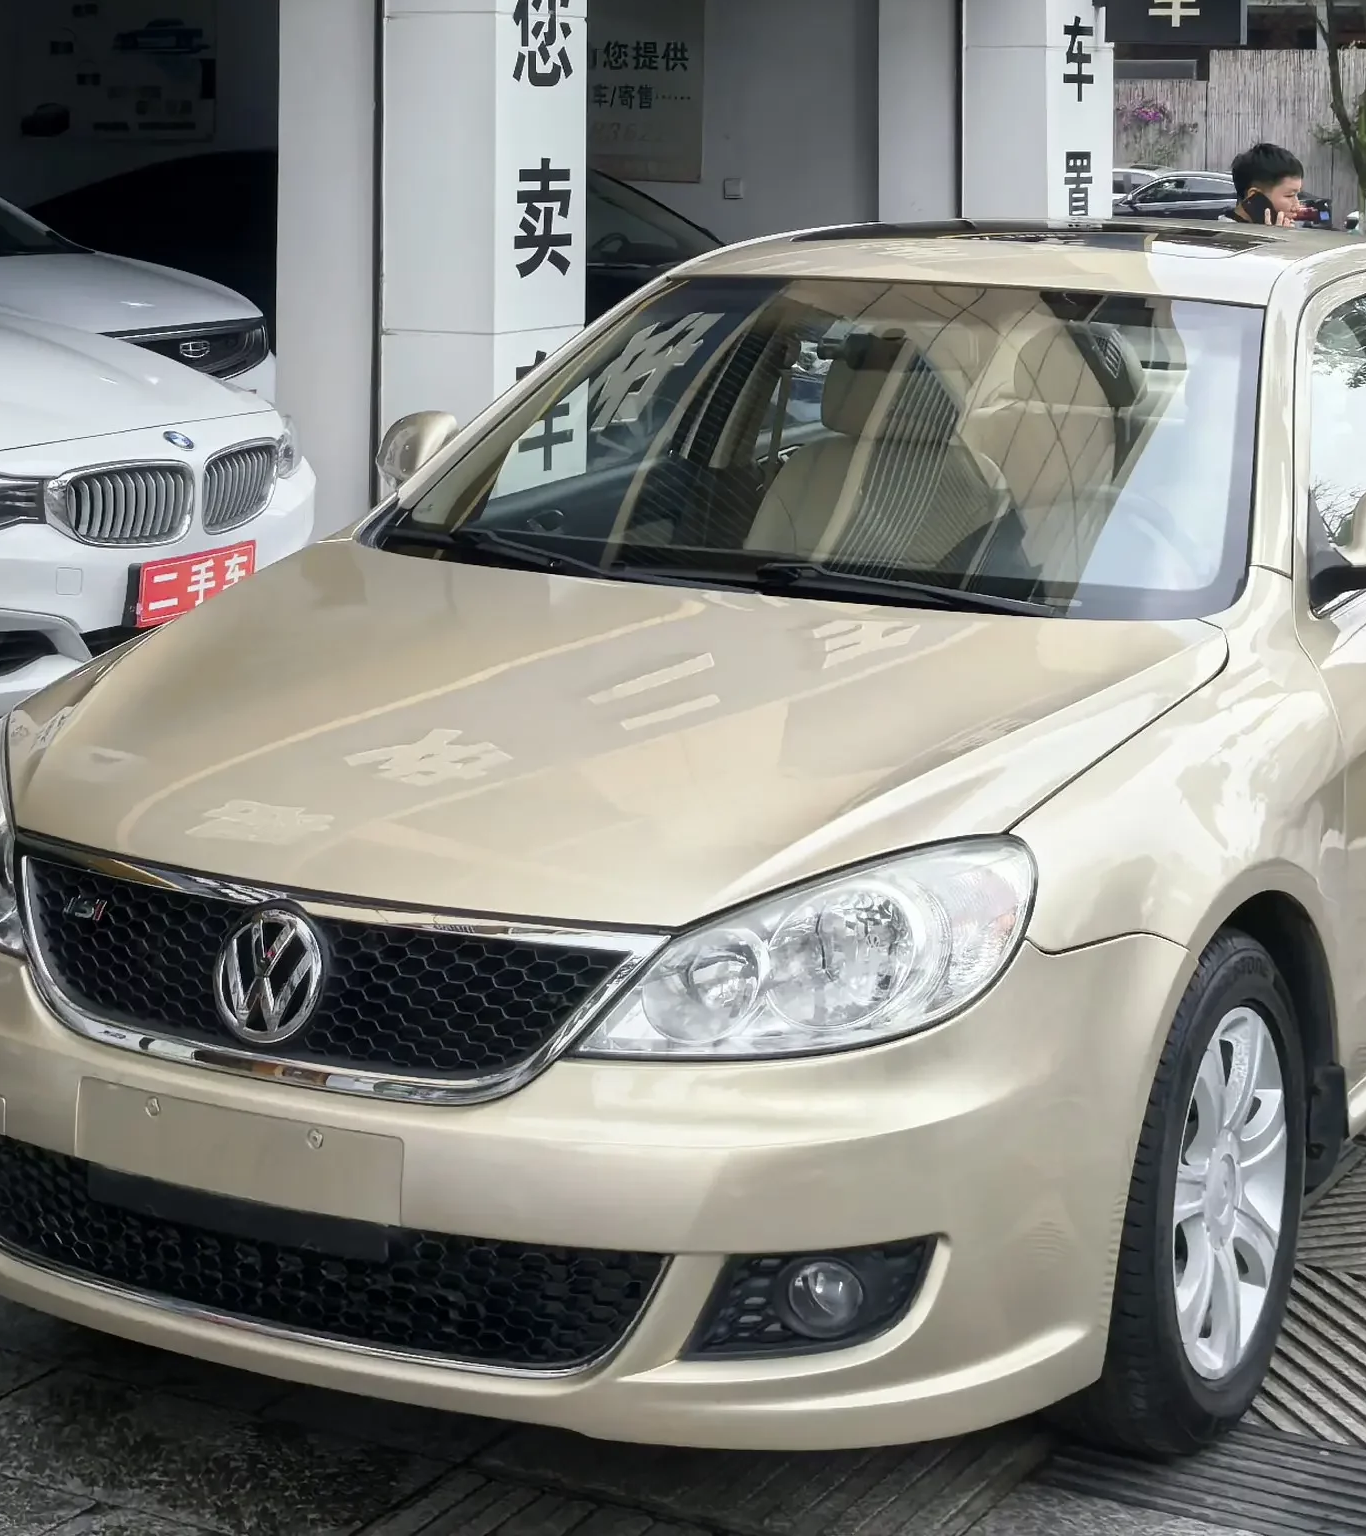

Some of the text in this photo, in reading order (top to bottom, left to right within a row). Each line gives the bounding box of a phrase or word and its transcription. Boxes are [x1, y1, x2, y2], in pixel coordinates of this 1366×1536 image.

[589, 40, 689, 71] 您提供
[149, 553, 248, 610] 二手车
